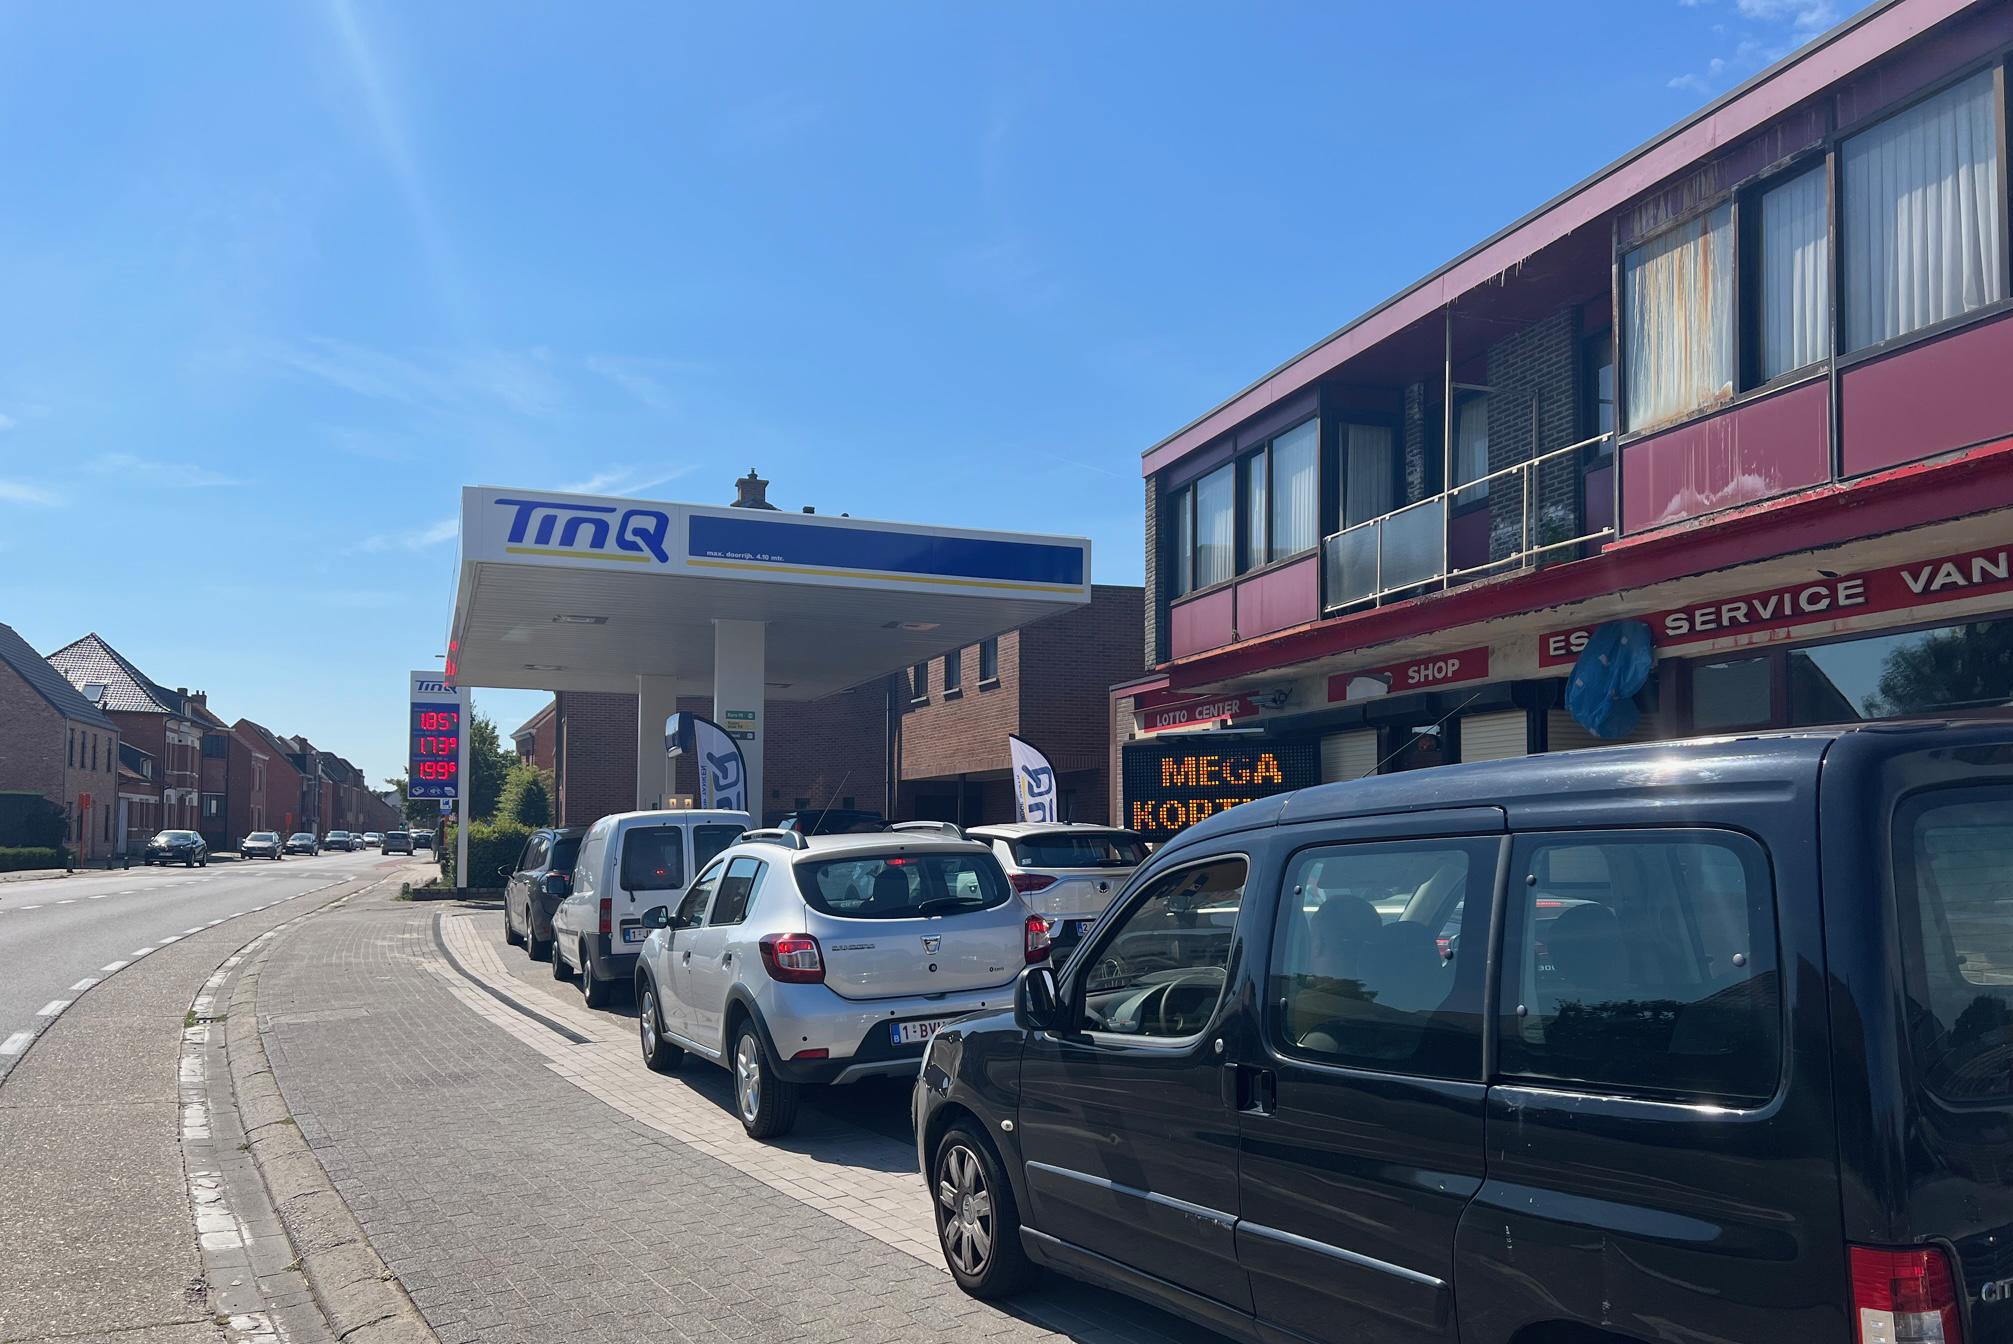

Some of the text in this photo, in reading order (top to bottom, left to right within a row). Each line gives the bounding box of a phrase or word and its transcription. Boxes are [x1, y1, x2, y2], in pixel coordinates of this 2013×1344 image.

[756, 553, 770, 561] 4.10
[1664, 578, 1867, 637] SERVICE
[1900, 551, 2009, 594] VAN
[1407, 658, 1461, 684] SHOP
[1156, 699, 1241, 727] LOTTO CENTER
[1161, 752, 1283, 788] MEGA
